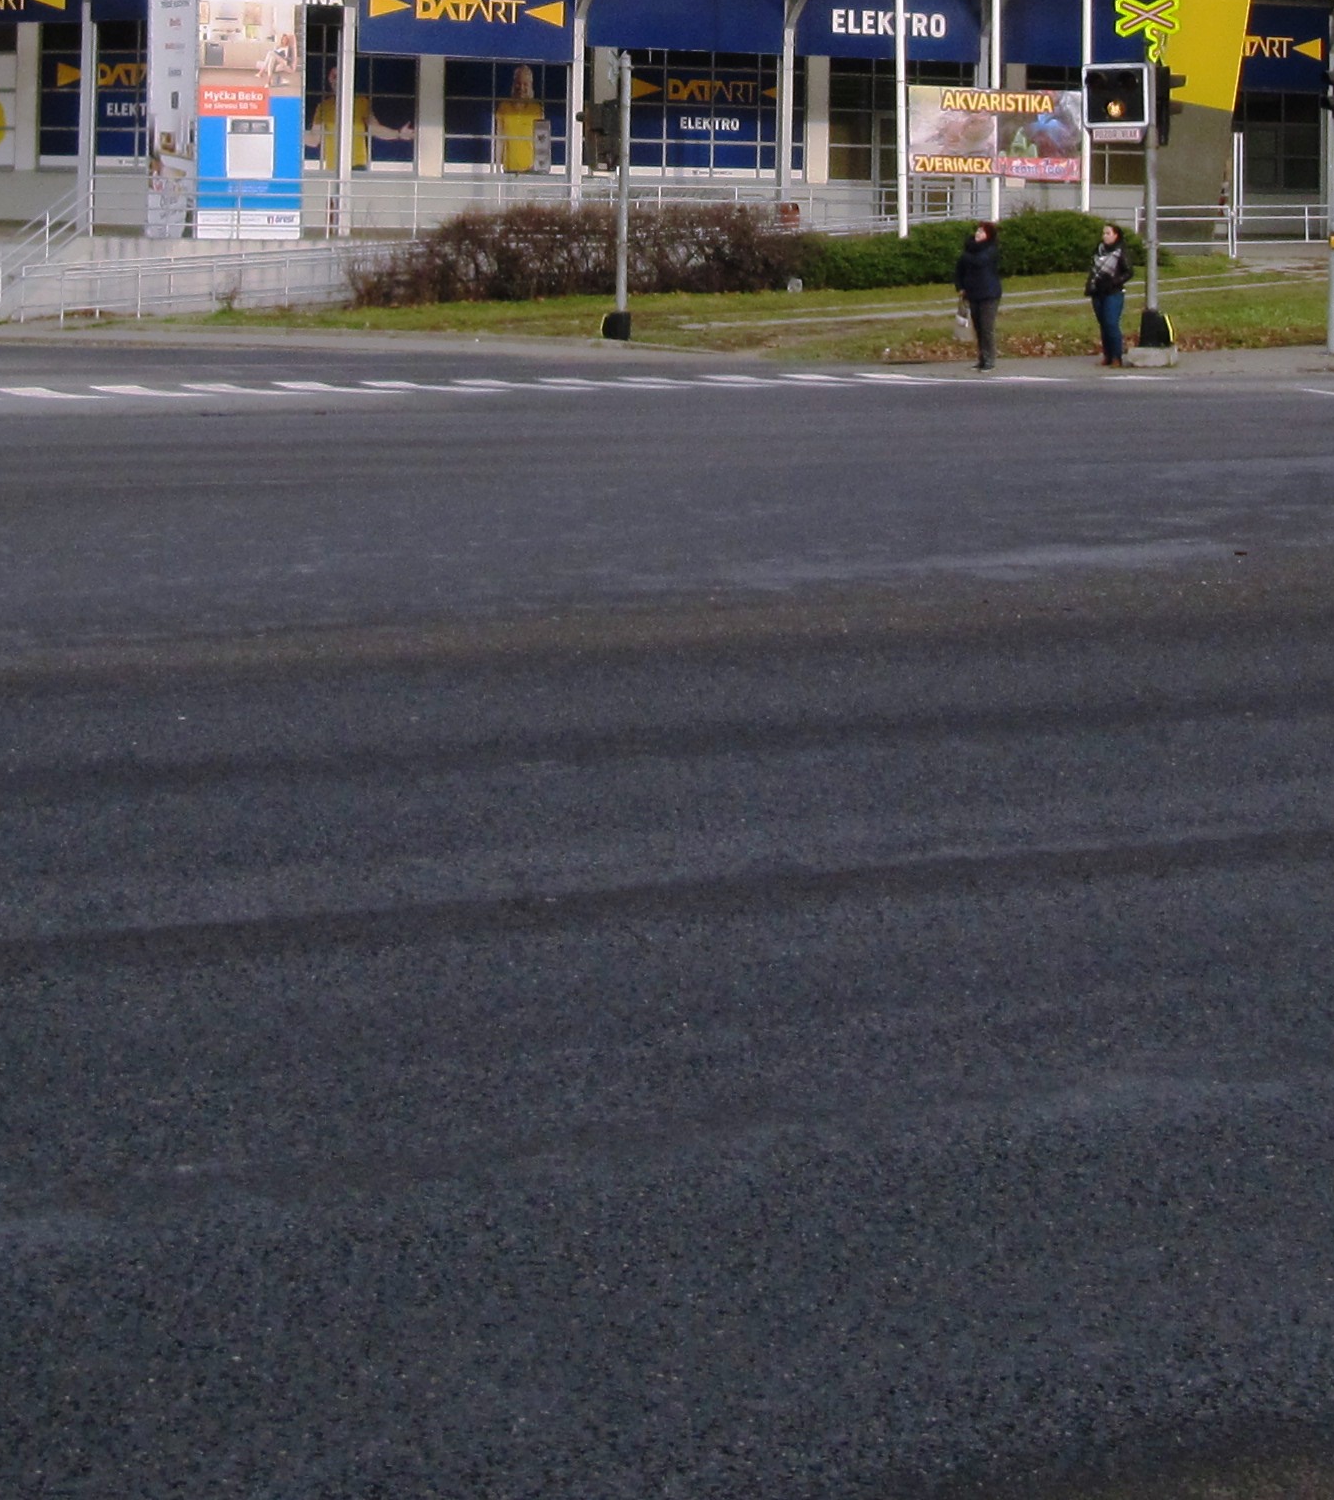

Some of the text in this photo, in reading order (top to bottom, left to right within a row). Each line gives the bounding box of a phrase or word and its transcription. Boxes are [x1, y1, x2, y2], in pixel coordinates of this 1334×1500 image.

[832, 8, 946, 38] ELEKTRO
[204, 90, 264, 101] Myčka Beko
[668, 79, 757, 102] DATART
[942, 91, 1054, 113] AKVARISTIKA
[680, 117, 740, 131] ELEKTRO
[914, 156, 994, 173] ZVERIMEX
